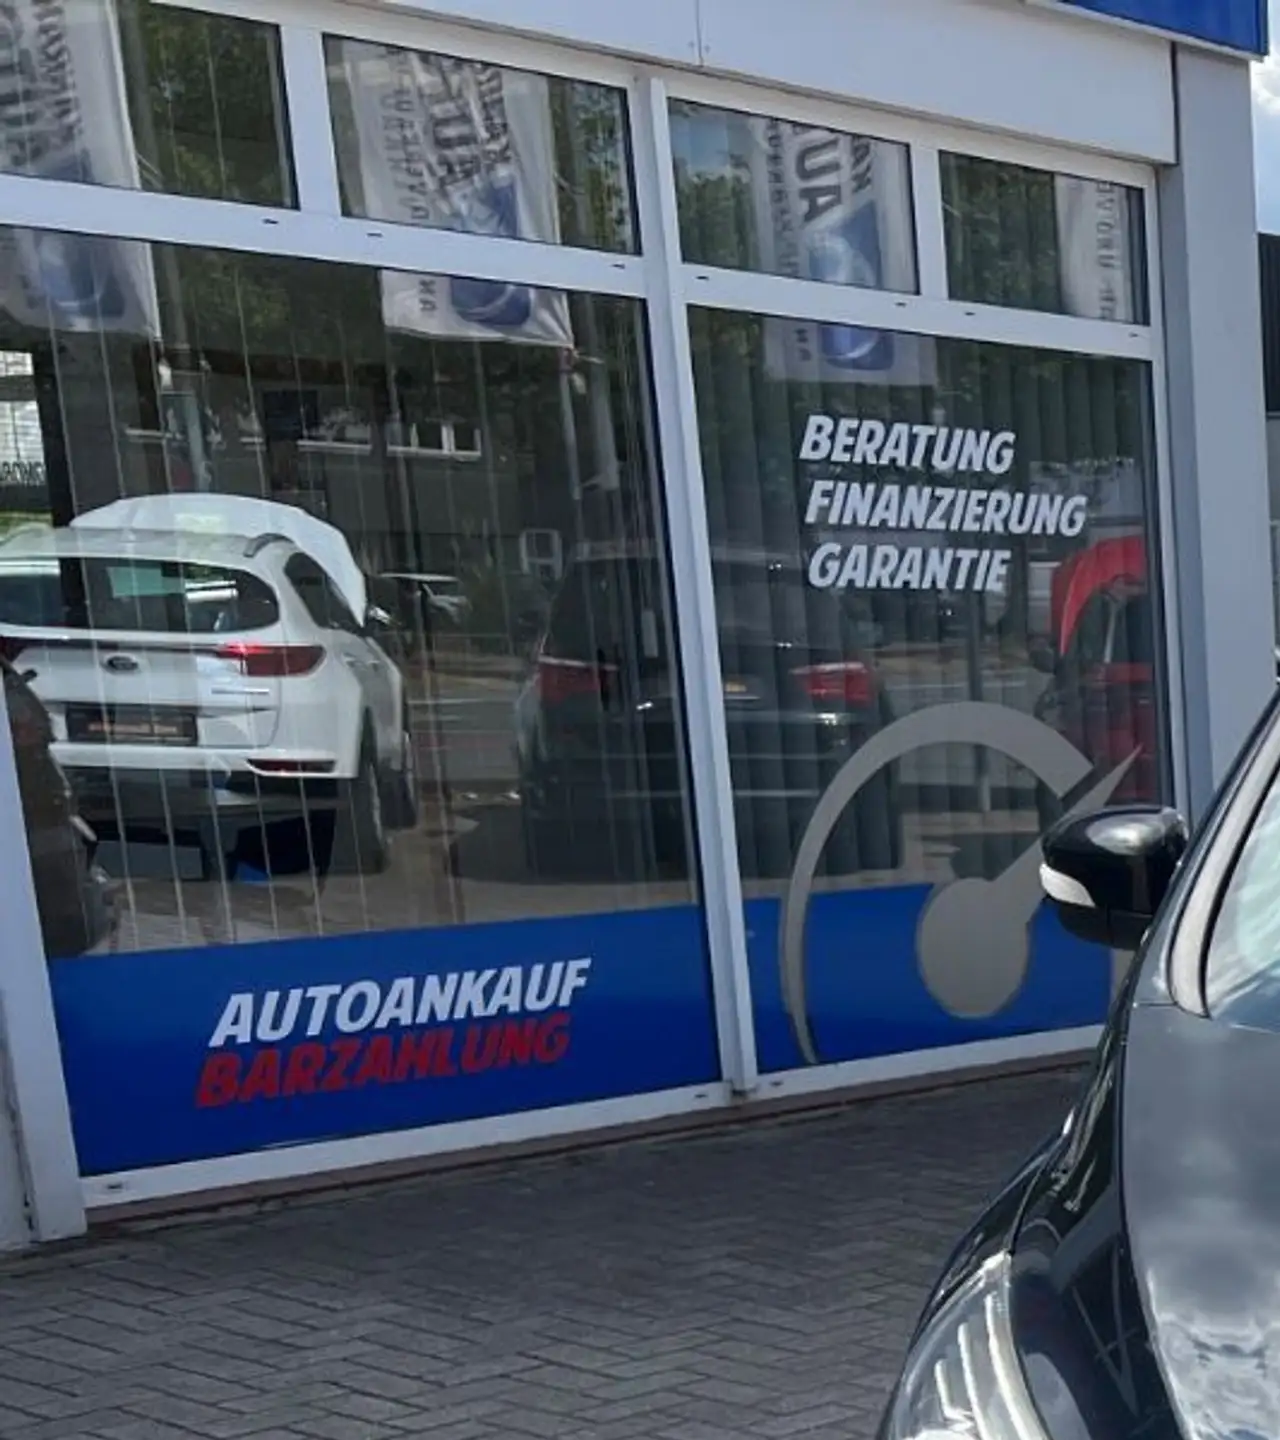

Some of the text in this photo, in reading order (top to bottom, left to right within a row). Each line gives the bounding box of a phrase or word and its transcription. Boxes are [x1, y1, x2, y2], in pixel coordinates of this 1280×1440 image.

[799, 414, 1017, 475] BERATUNG
[804, 480, 1088, 537] FINANZIERUNG
[808, 542, 1011, 592] GARANTIE
[208, 957, 592, 1048] AUTOANKAUF
[196, 1012, 572, 1109] BARZAHLUNG
